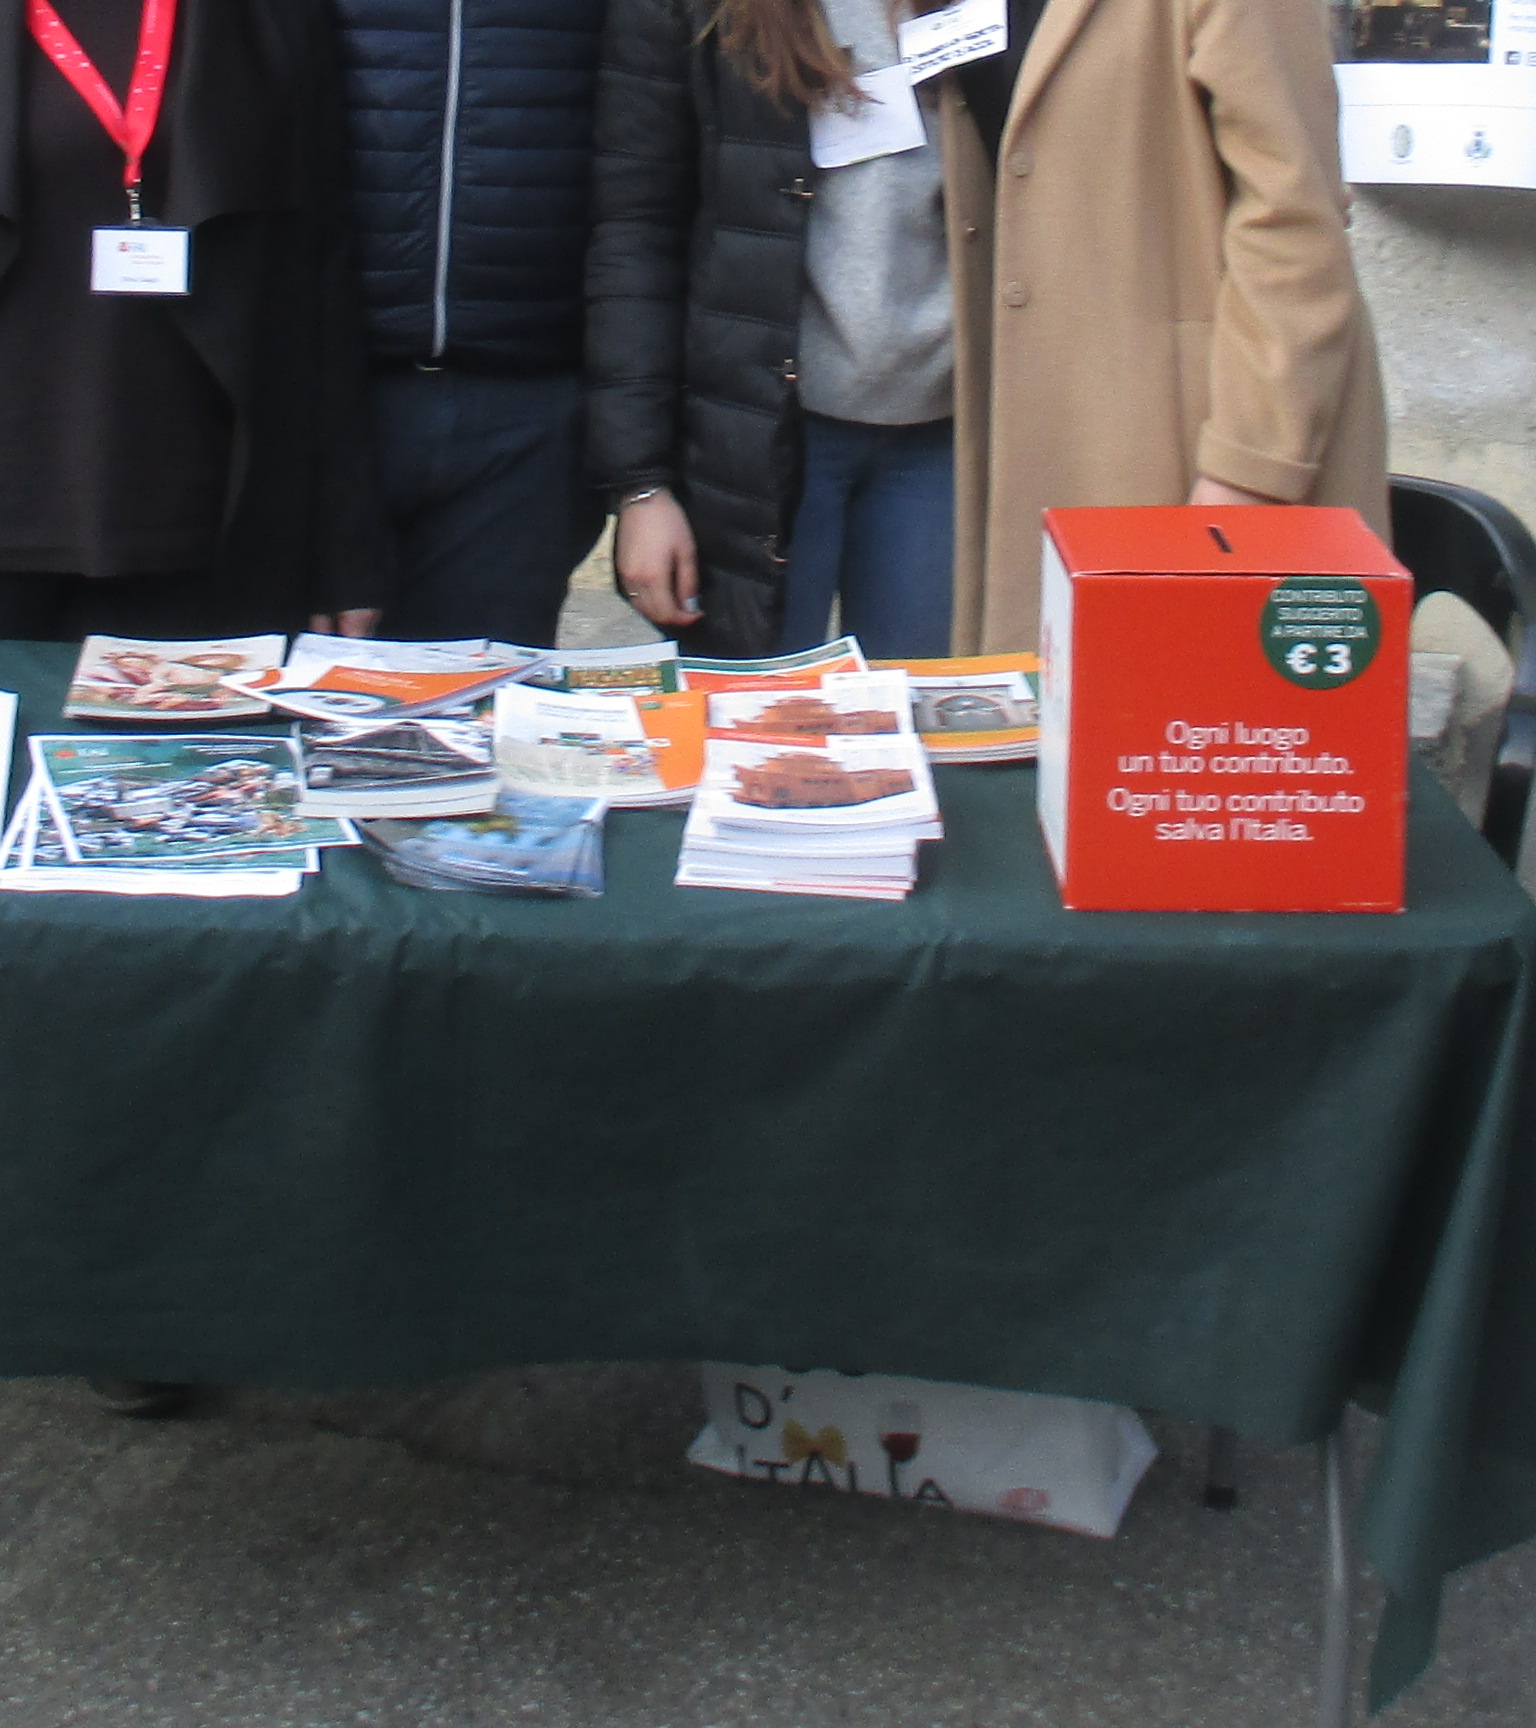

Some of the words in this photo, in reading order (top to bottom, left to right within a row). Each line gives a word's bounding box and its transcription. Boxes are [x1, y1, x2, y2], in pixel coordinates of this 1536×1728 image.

[1270, 589, 1369, 603] CONTRIBUTO
[1277, 607, 1364, 621] SUGGERITO
[1165, 720, 1230, 750] Ogni
[1234, 721, 1310, 751] luogo
[1117, 754, 1155, 773] un
[1159, 750, 1205, 773] tuo
[1209, 750, 1355, 774] contributo.
[1106, 787, 1171, 817] Ogni
[1175, 789, 1222, 812] tuo
[1225, 789, 1365, 813] contributo
[1155, 817, 1225, 841] salva
[1229, 818, 1314, 841] l'Italia.
